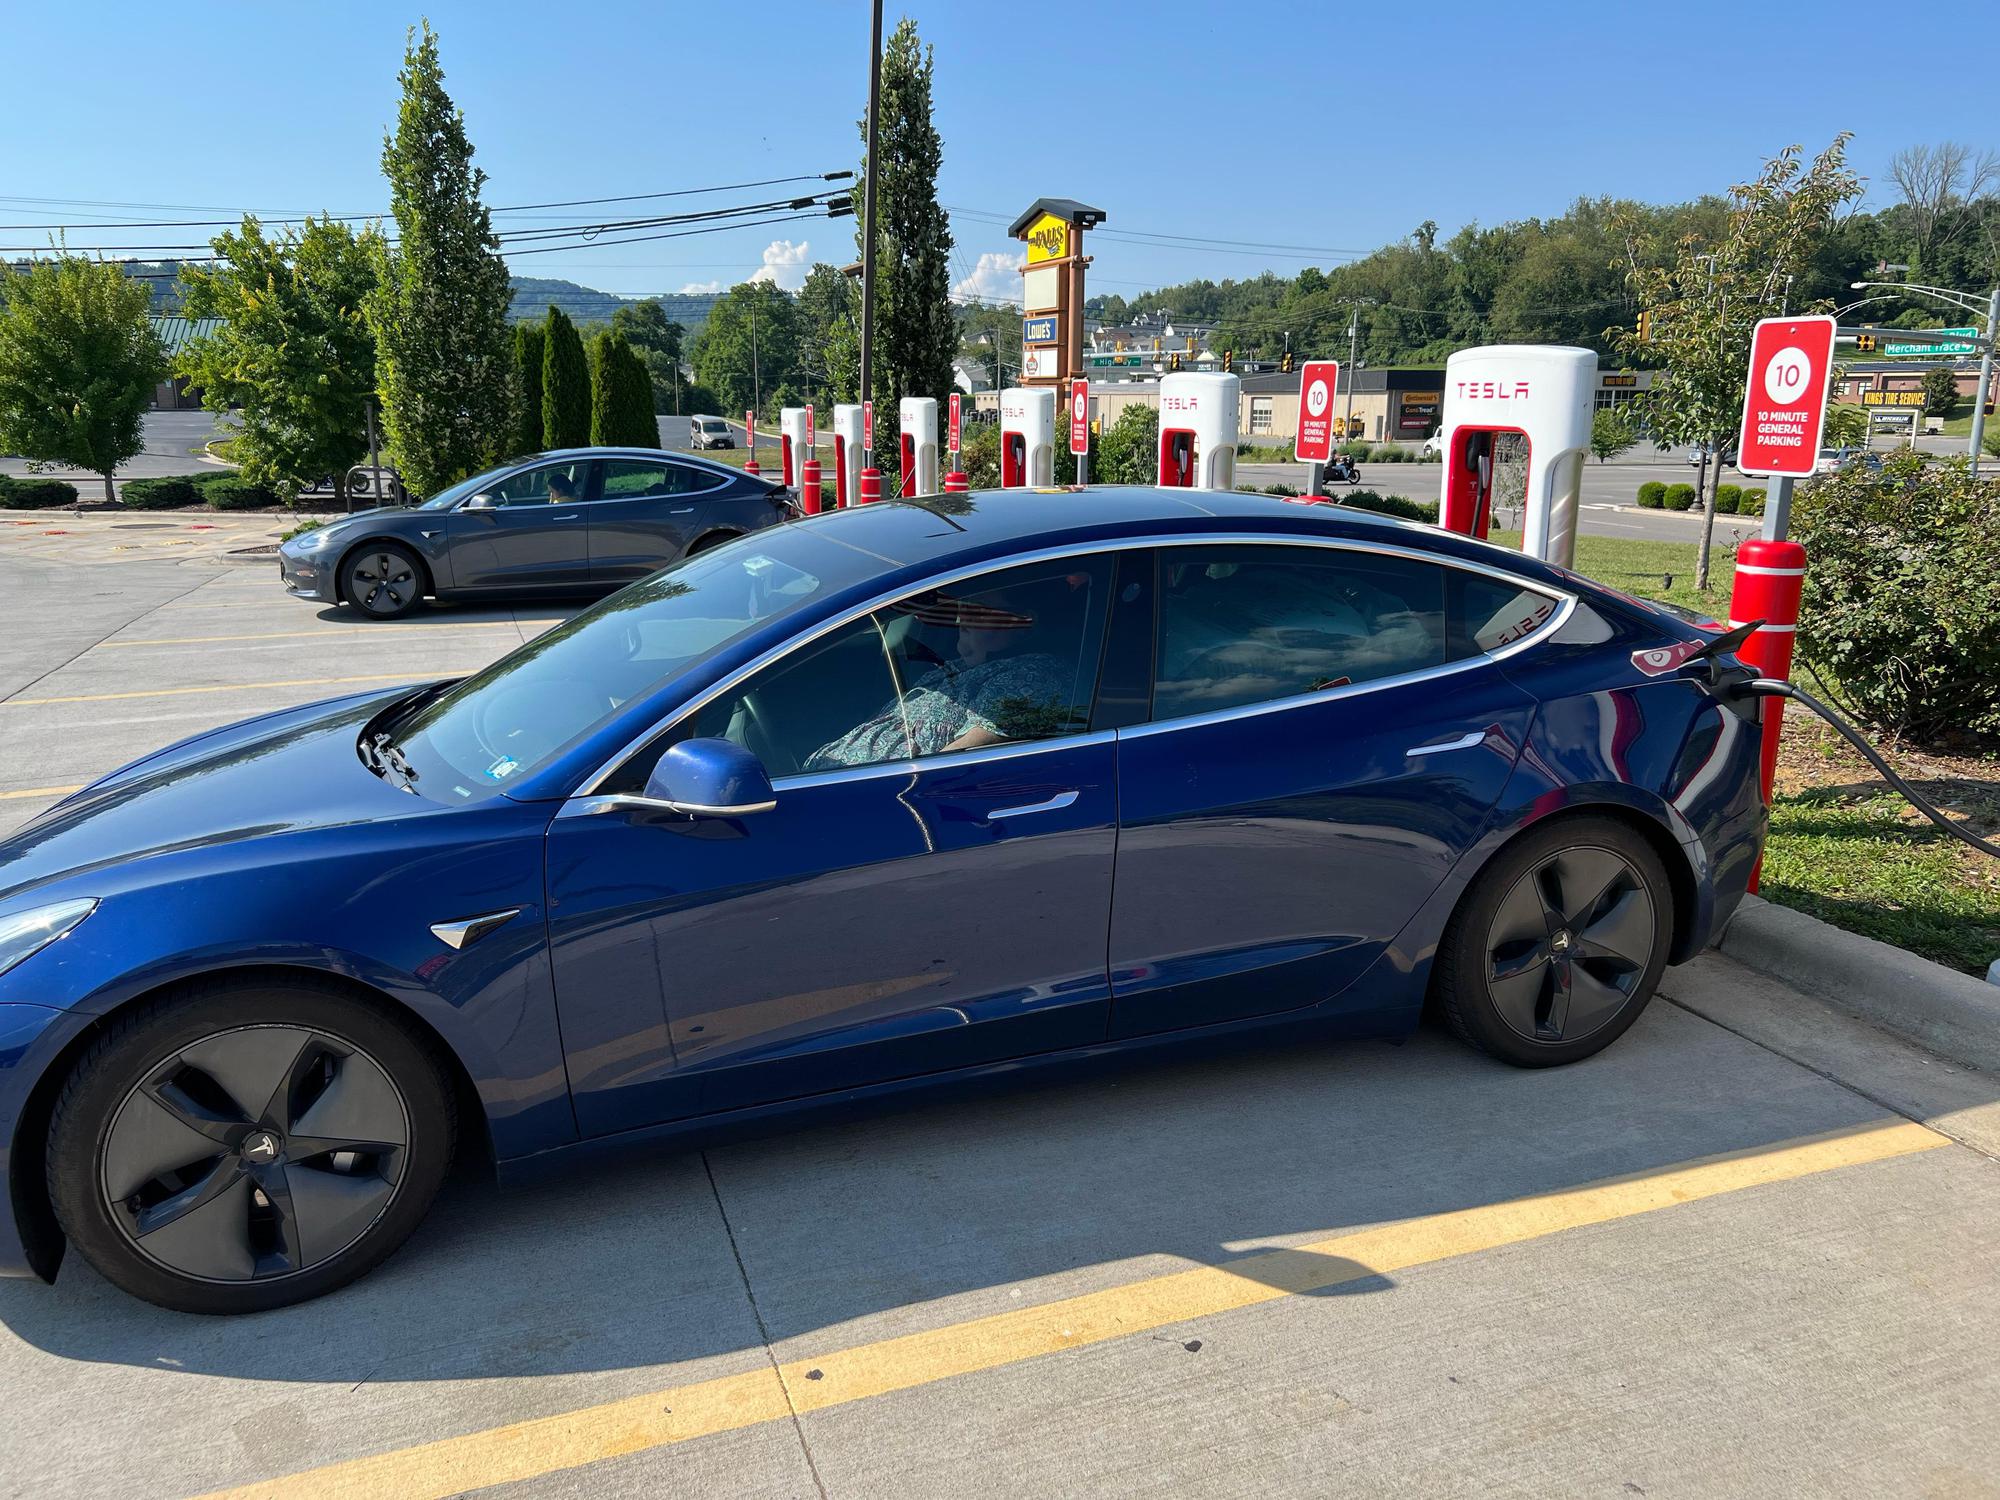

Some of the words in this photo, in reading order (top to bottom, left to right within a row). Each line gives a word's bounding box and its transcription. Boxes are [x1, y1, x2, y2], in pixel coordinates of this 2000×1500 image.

[1887, 344, 1932, 354] Merchant
[1776, 364, 1801, 388] 10
[1457, 382, 1530, 400] TESLA
[1312, 390, 1324, 406] 10
[1863, 391, 1884, 405] KINGS
[1884, 392, 1899, 405] TIRE
[1898, 392, 1926, 406] SERVICE
[1162, 398, 1198, 411] TESLA
[1757, 411, 1769, 422] 10
[1769, 411, 1809, 423] MINUTE
[1303, 428, 1326, 436] GENERAL
[1757, 423, 1805, 435] GENERAL
[1303, 435, 1325, 445] PARKING
[1757, 435, 1802, 447] PARKING
